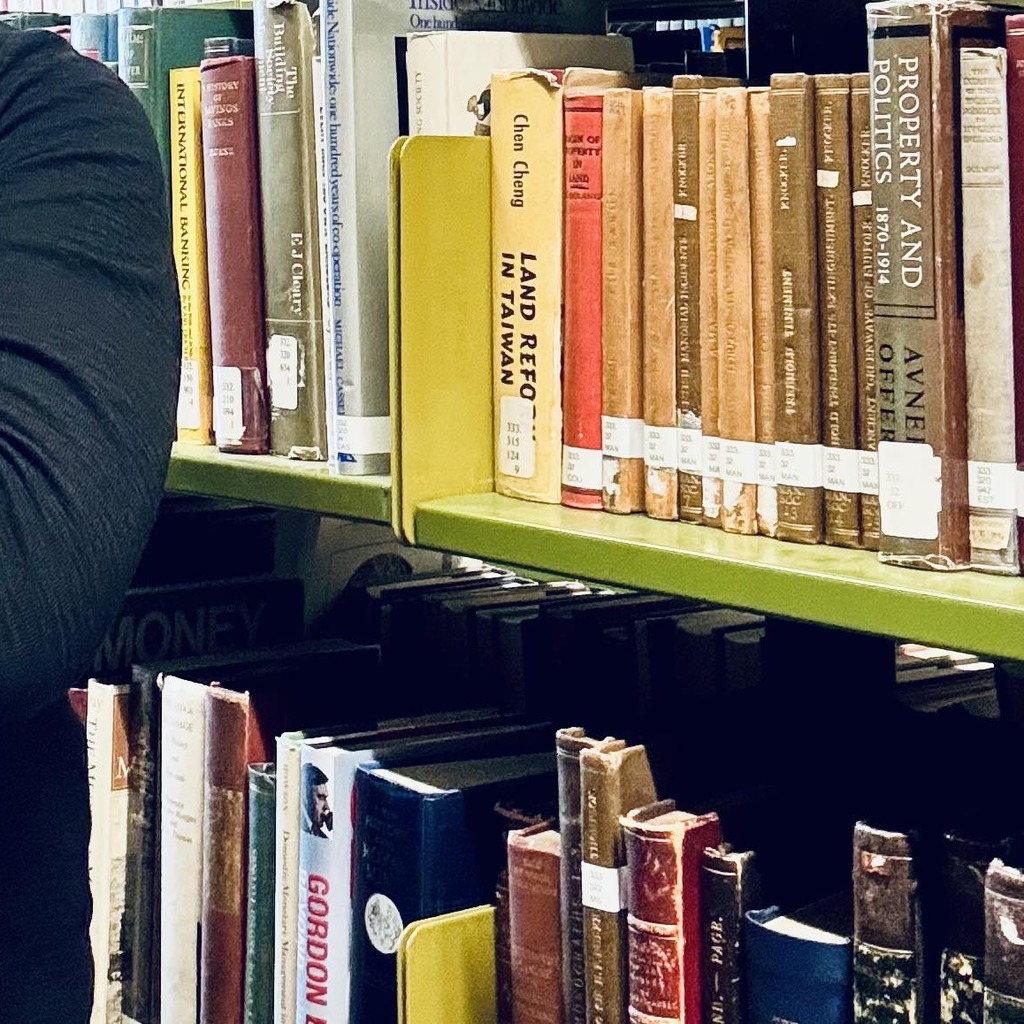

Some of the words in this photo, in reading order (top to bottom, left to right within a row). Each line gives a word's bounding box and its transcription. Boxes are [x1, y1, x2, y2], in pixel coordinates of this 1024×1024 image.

[409, 14, 433, 29] One
[272, 22, 286, 94] Building
[286, 66, 298, 98] The
[327, 97, 340, 121] one
[874, 58, 891, 185] POLITICS
[175, 83, 187, 208] INTERNATIONAL
[328, 123, 342, 177] hundred
[513, 113, 530, 152] Chen
[587, 135, 600, 144] OF
[896, 56, 922, 209] PROPERTY
[510, 162, 528, 208] Cheng
[572, 159, 582, 169] IN
[329, 179, 342, 210] years
[290, 231, 301, 245] E
[330, 212, 343, 225] of
[178, 216, 189, 290] BANKING
[290, 248, 302, 259] J
[501, 252, 516, 278] IN
[875, 206, 890, 286] 1870-1914
[900, 219, 923, 287] AND
[520, 252, 538, 322] LAND
[334, 319, 343, 369] MICHAEL
[500, 285, 515, 386] TAIWAN
[520, 333, 539, 442] REFO
[506, 450, 520, 461] 124
[507, 436, 521, 448] 315
[514, 464, 520, 476] 9
[94, 603, 266, 671] MONEY
[306, 874, 330, 1007] GORDON
